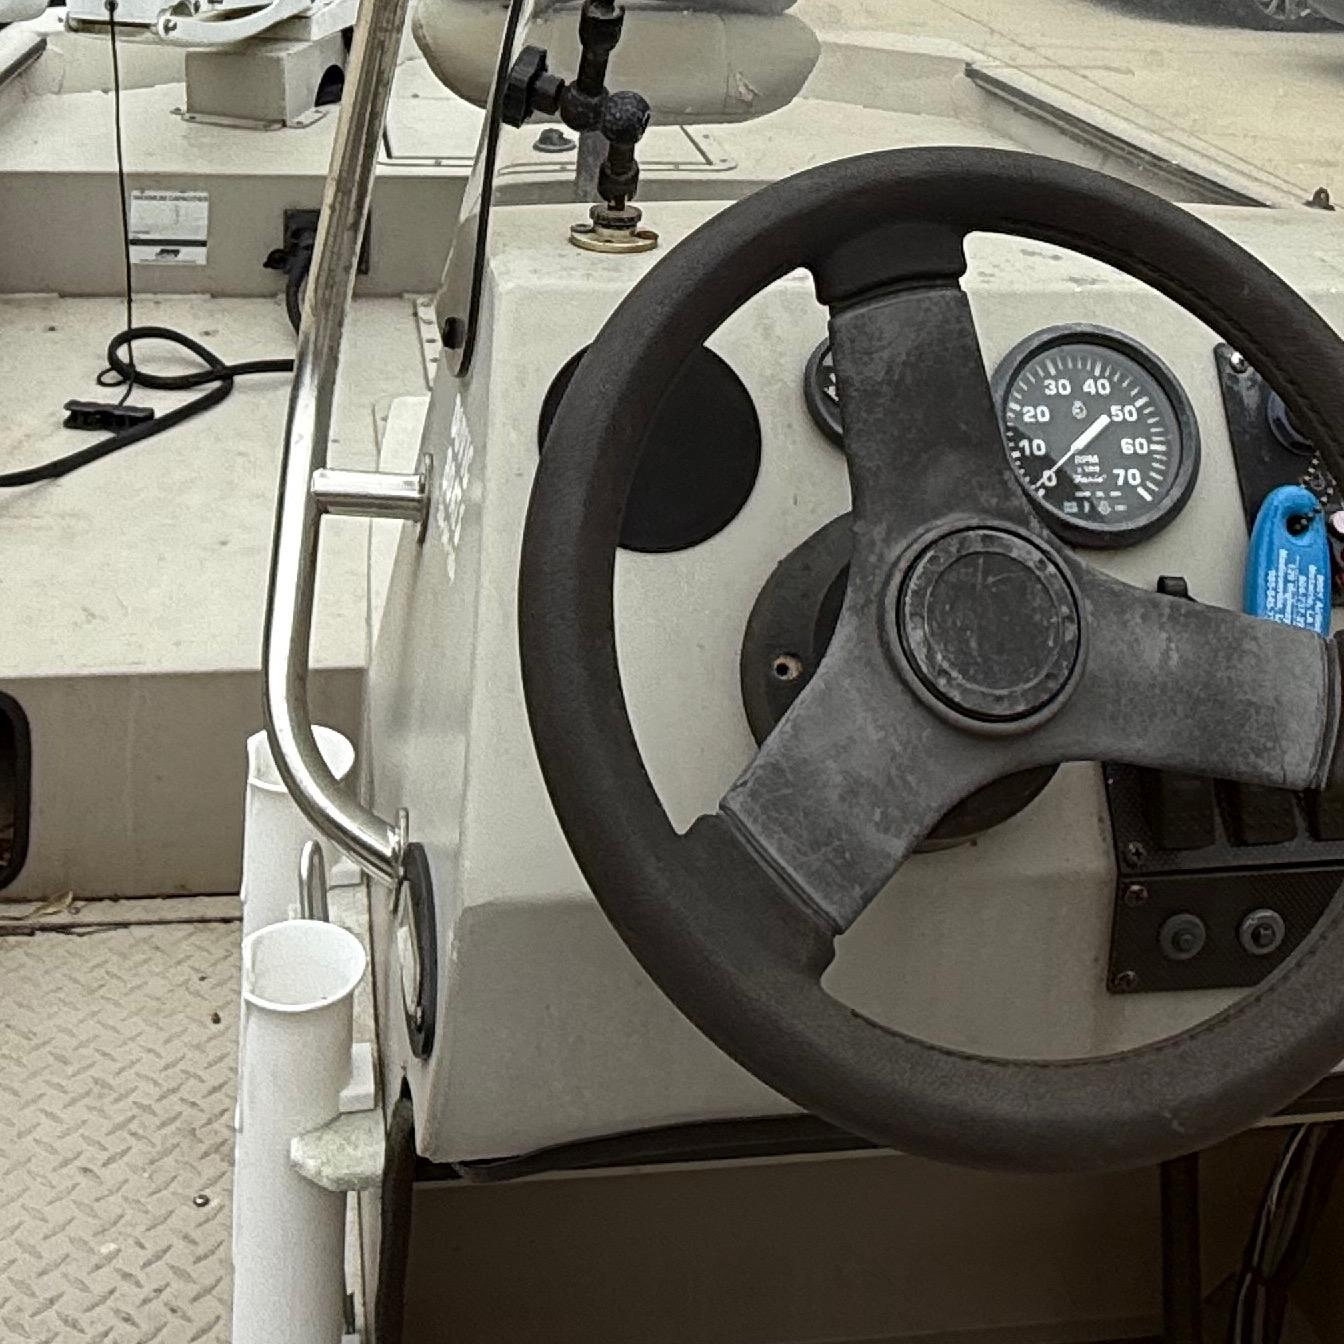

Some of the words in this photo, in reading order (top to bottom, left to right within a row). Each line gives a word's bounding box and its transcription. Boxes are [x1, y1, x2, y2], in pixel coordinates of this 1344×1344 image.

[1043, 378, 1071, 396] 30
[1082, 378, 1111, 396] 40
[1022, 405, 1050, 423] 20
[1110, 405, 1138, 422] 50
[1018, 438, 1046, 456] 10
[1120, 438, 1148, 454] 60
[1042, 469, 1057, 487] 0
[1112, 468, 1142, 486] 70
